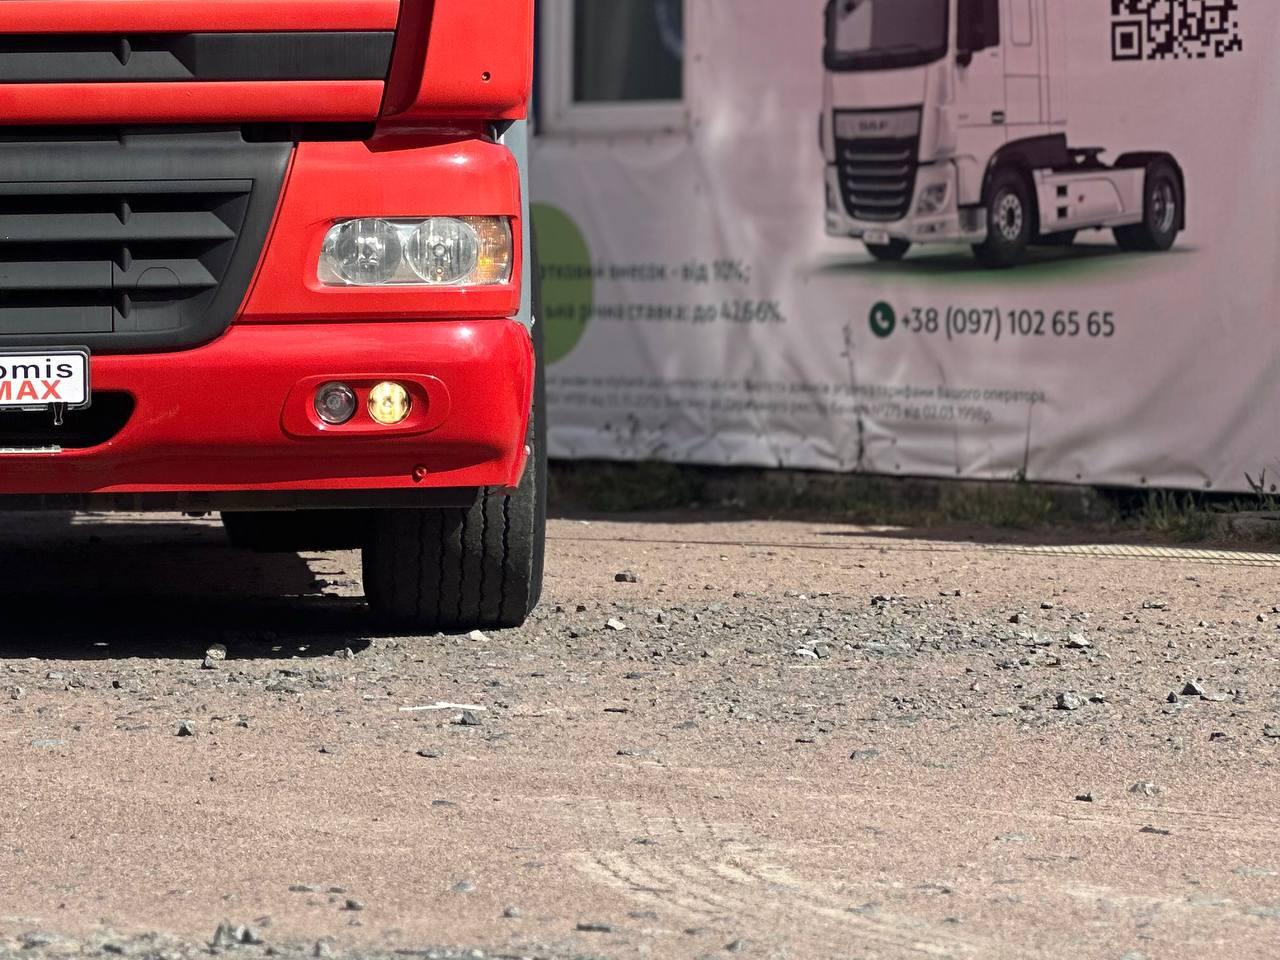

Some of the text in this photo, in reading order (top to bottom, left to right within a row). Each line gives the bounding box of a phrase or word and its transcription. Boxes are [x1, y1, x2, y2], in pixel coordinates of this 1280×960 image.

[901, 306, 1115, 341] +38 (097) 102 65 65
